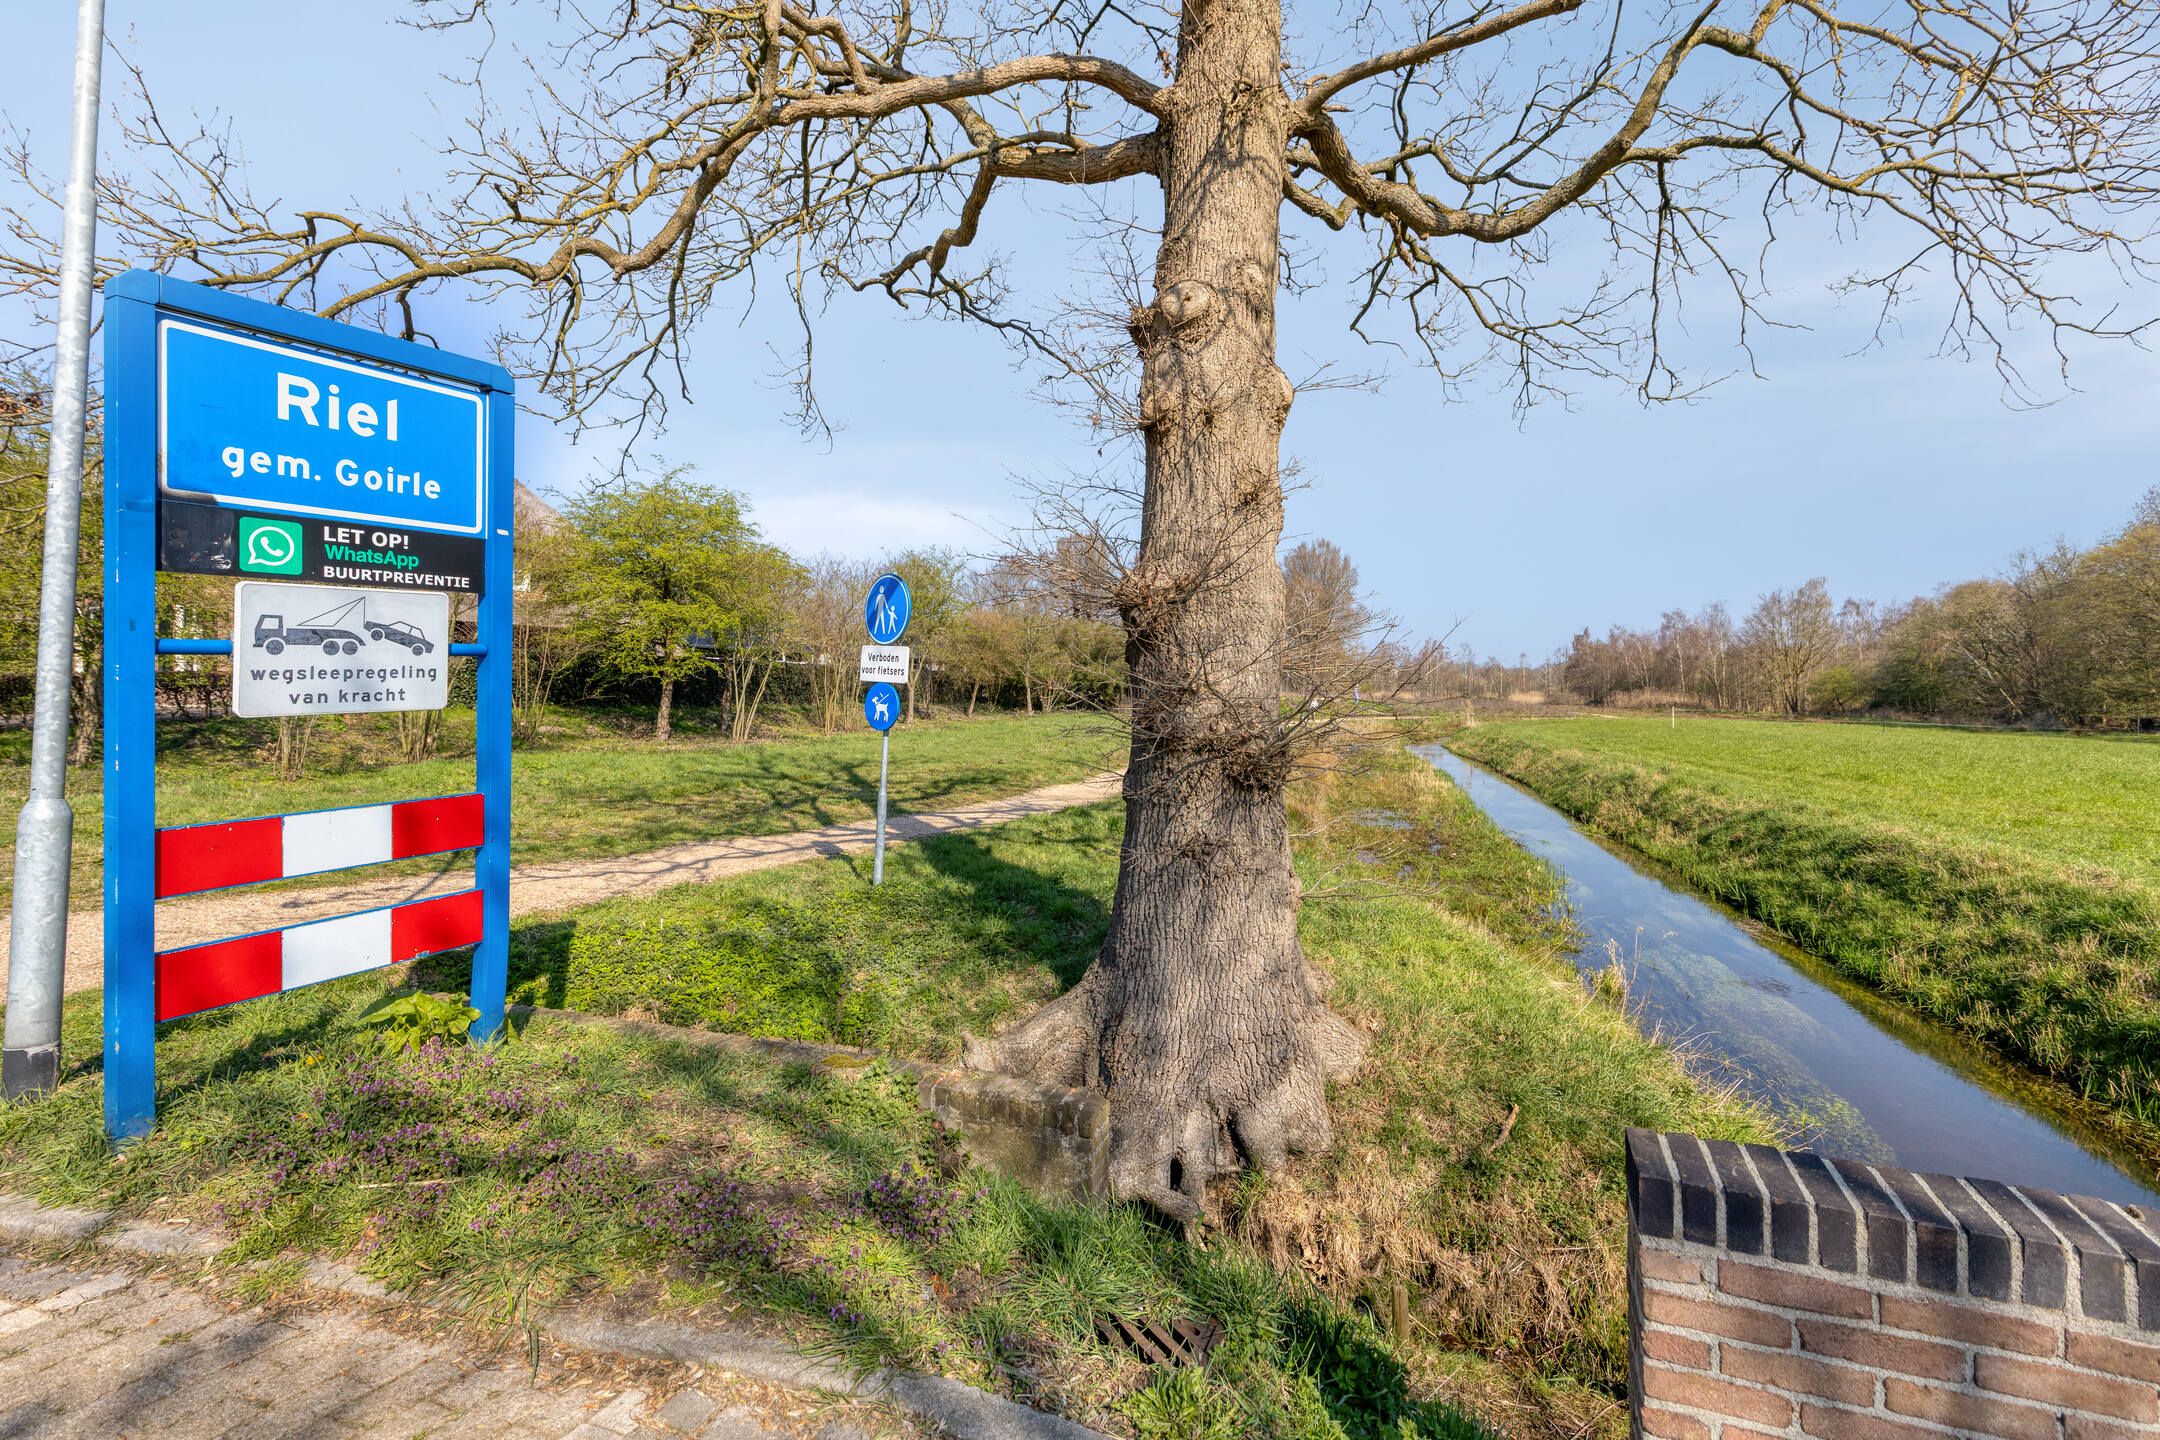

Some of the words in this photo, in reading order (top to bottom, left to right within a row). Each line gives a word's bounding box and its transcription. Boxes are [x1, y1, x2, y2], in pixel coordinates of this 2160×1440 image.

[276, 371, 398, 442] Riel
[222, 446, 321, 481] gem.
[335, 459, 441, 500] Goirle
[323, 526, 365, 545] LET
[371, 530, 409, 550] OP!
[324, 543, 420, 570] WhatsApp
[323, 565, 470, 589] BUURTPREVENTIE
[868, 652, 899, 662] Verboden
[250, 665, 438, 684] wegsleepregeling
[861, 666, 876, 674] voor
[877, 665, 905, 676] fietsers
[289, 692, 329, 705] van
[338, 688, 406, 703] kracht
